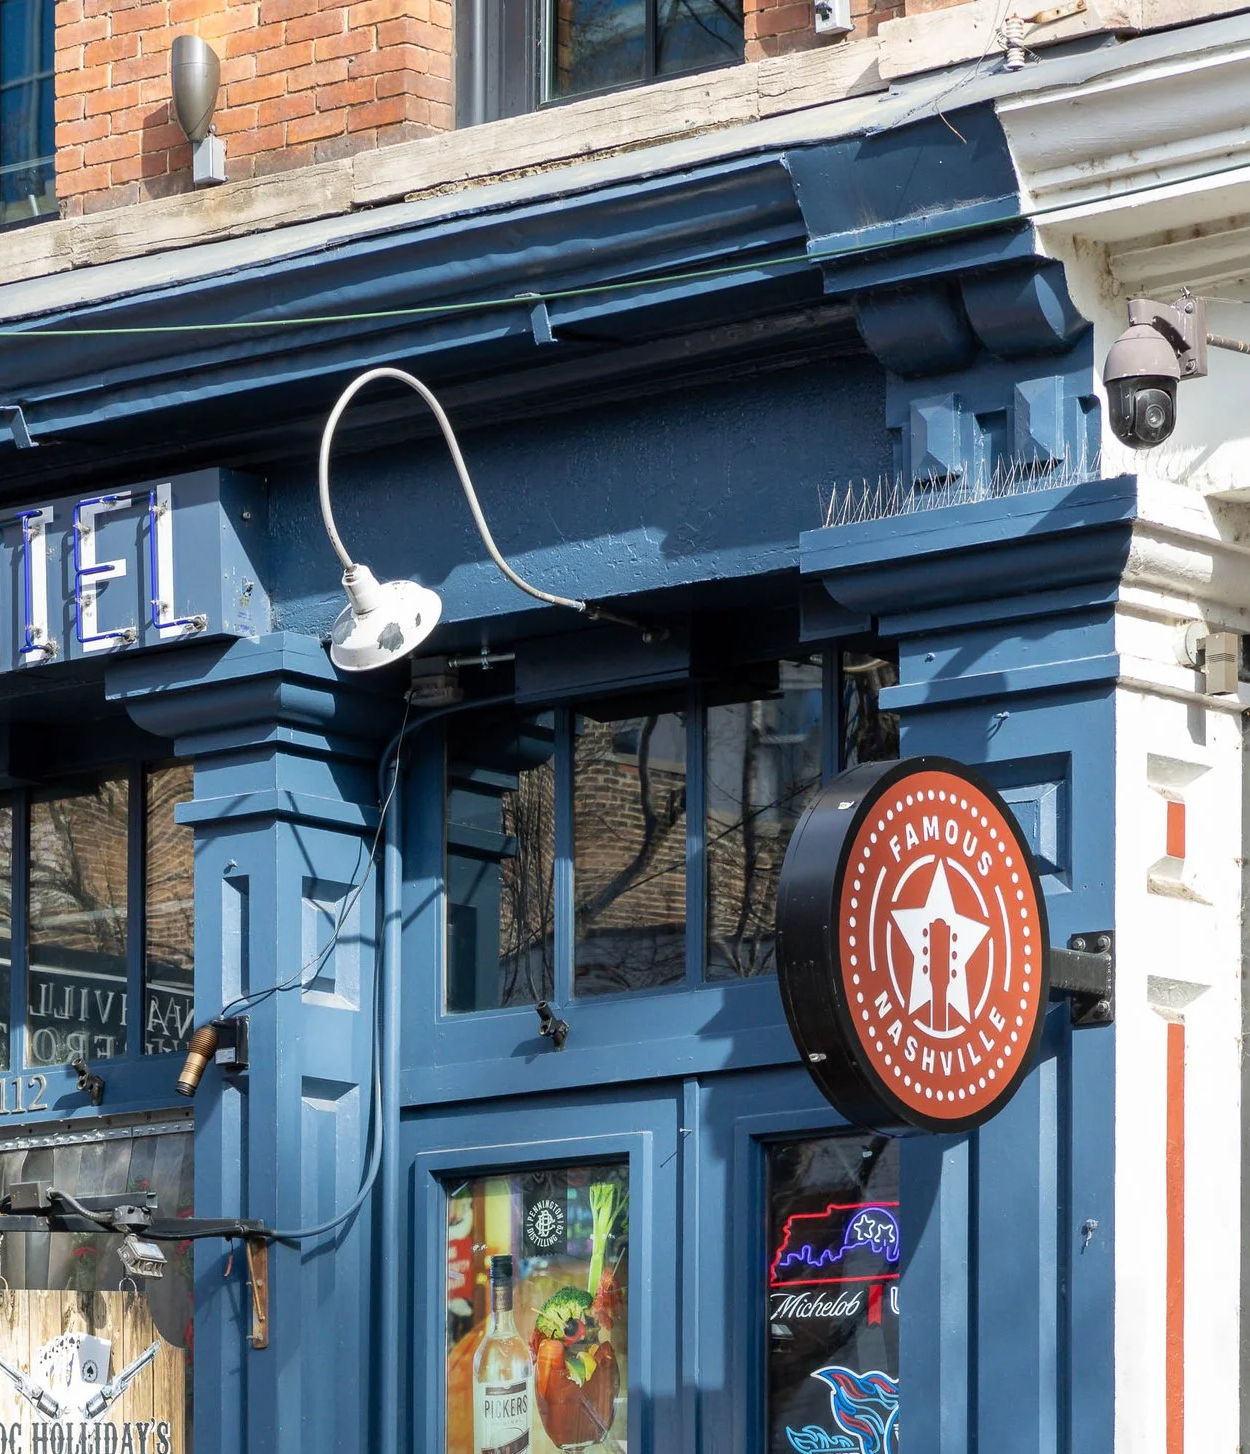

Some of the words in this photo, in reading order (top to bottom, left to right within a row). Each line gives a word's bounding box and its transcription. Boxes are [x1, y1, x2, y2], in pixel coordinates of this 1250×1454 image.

[889, 815, 993, 877] FAMOUS
[874, 989, 1006, 1077] NASHVILLE
[526, 1199, 564, 1222] PENNINGTON
[526, 1227, 558, 1248] DISTILLING
[770, 1290, 865, 1321] Michelob
[484, 1394, 528, 1419] PICKERS
